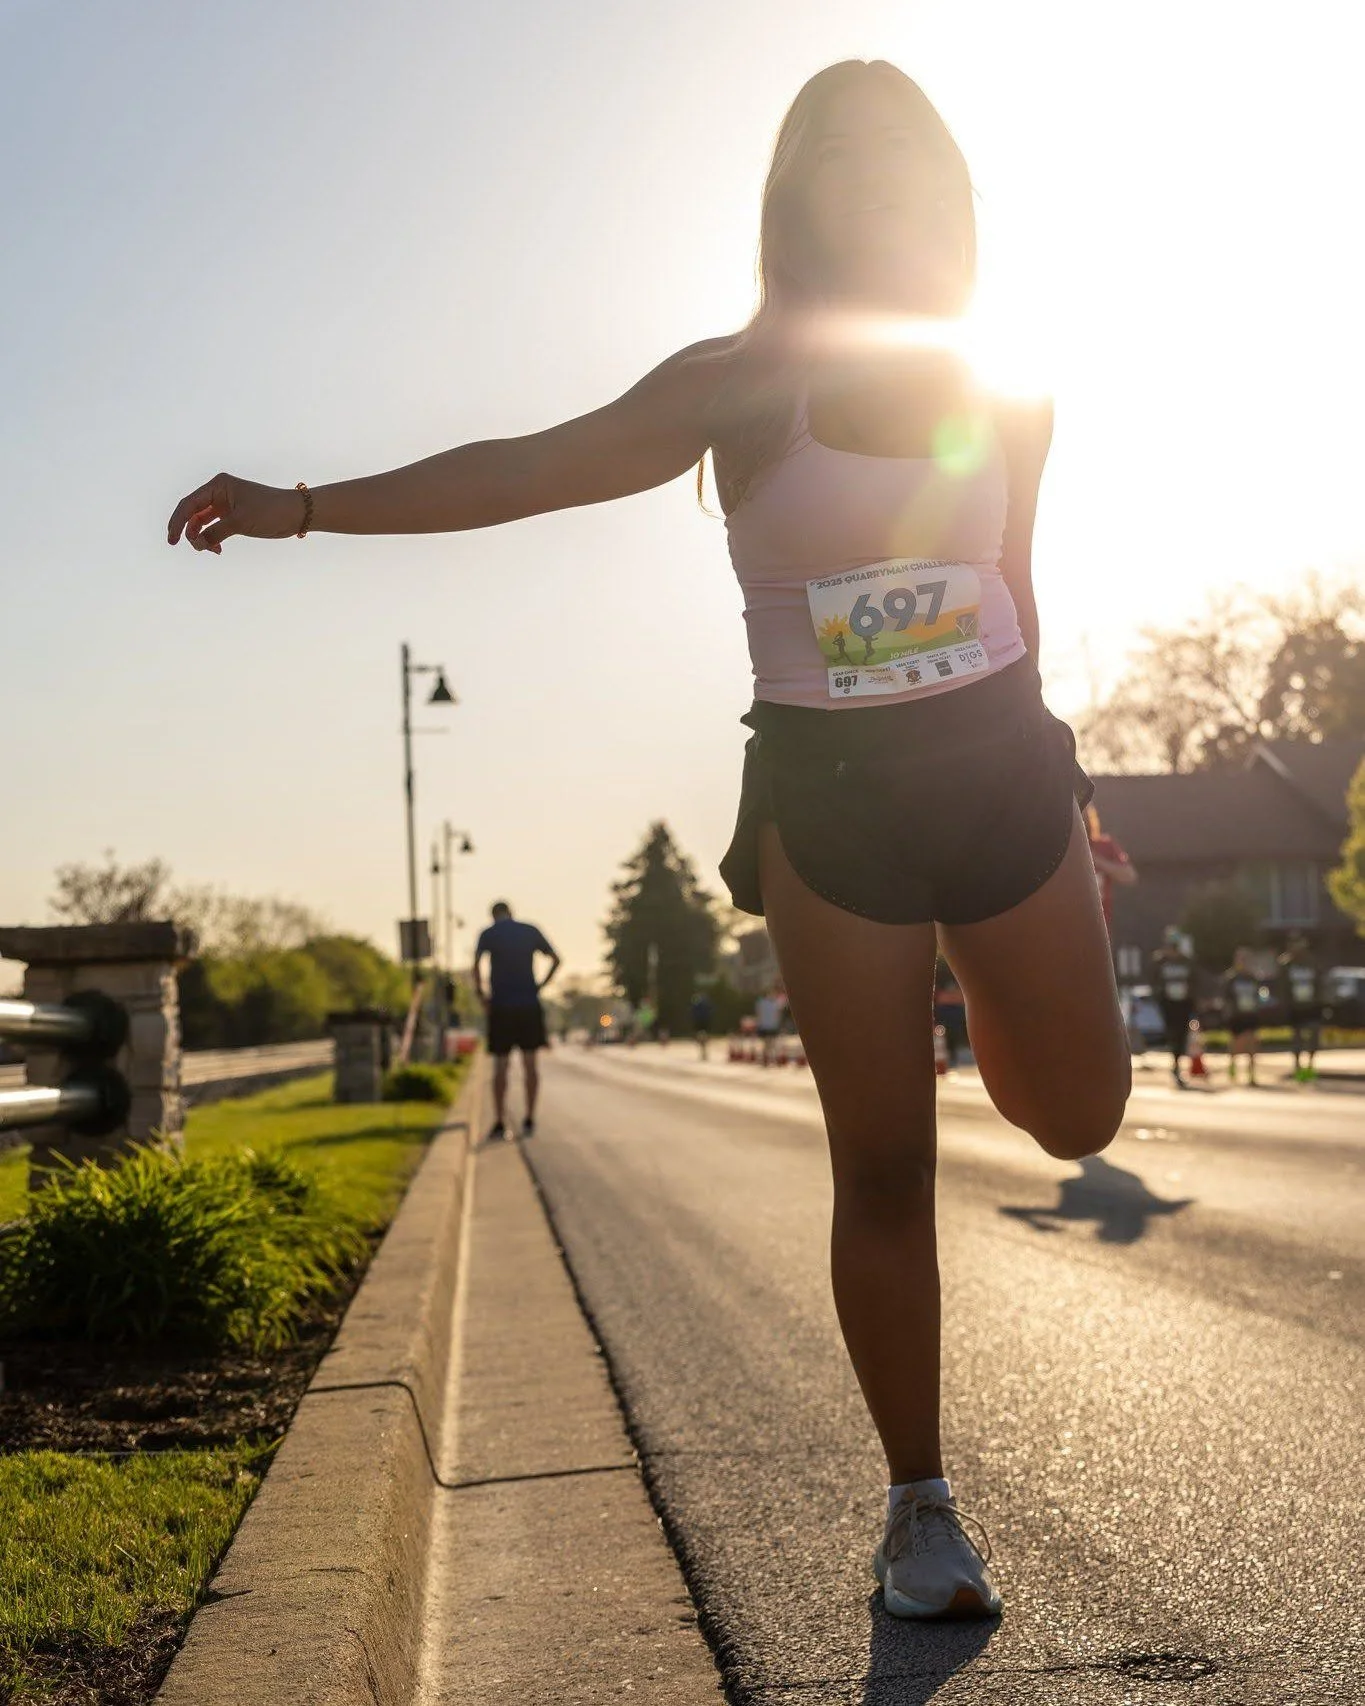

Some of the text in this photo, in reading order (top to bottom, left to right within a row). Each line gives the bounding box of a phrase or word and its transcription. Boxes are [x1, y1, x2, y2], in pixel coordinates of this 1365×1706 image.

[816, 577, 843, 589] 2025
[844, 564, 910, 584] QUARRYMAN
[849, 580, 947, 637] 697
[835, 675, 858, 688] 697
